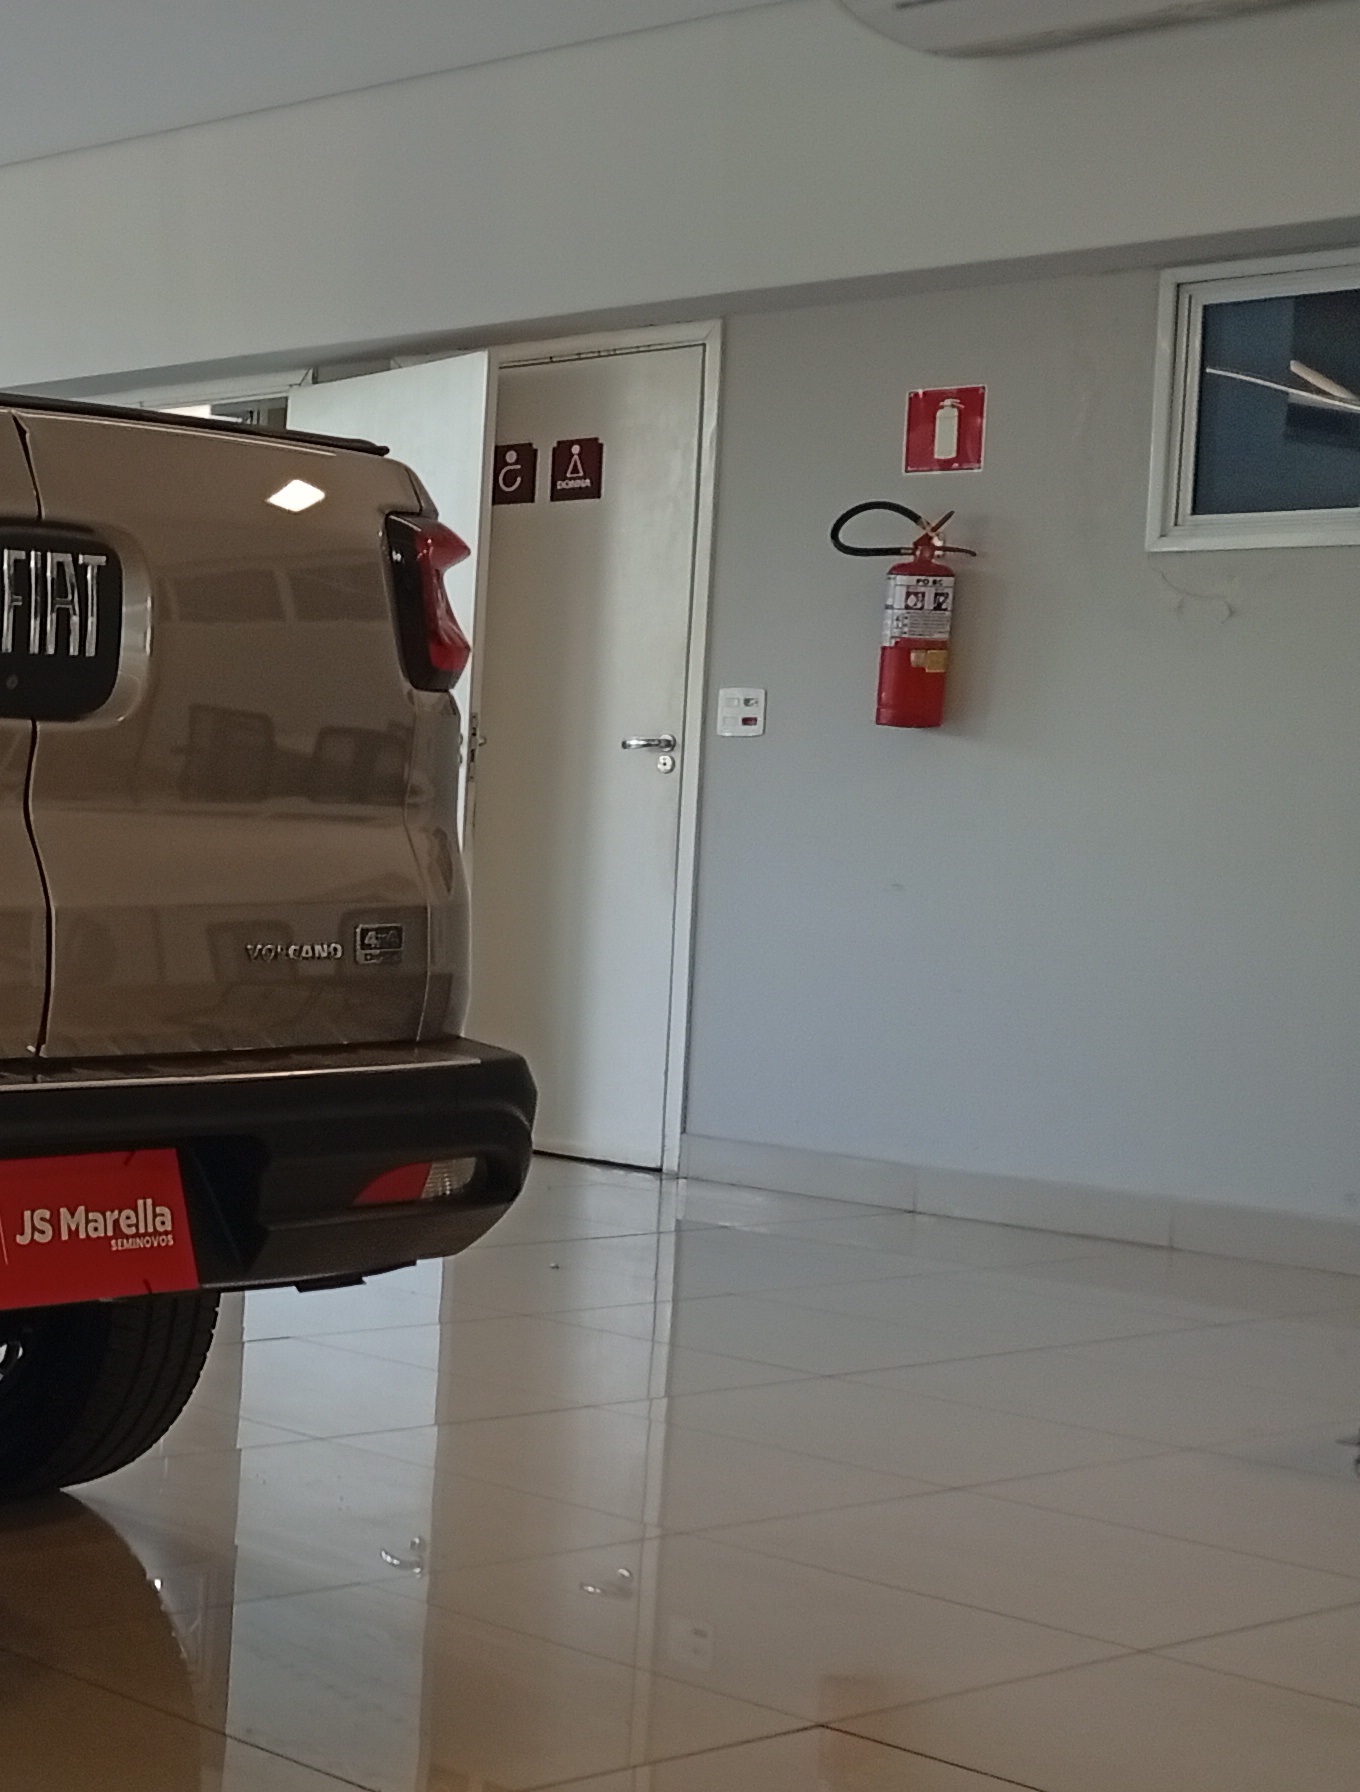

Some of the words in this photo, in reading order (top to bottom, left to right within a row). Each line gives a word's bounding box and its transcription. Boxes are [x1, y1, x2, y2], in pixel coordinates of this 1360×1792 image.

[1, 548, 107, 657] FIAT
[16, 1209, 53, 1245] JS
[60, 1198, 173, 1241] Marella
[111, 1234, 174, 1251] SEMINOVOS
